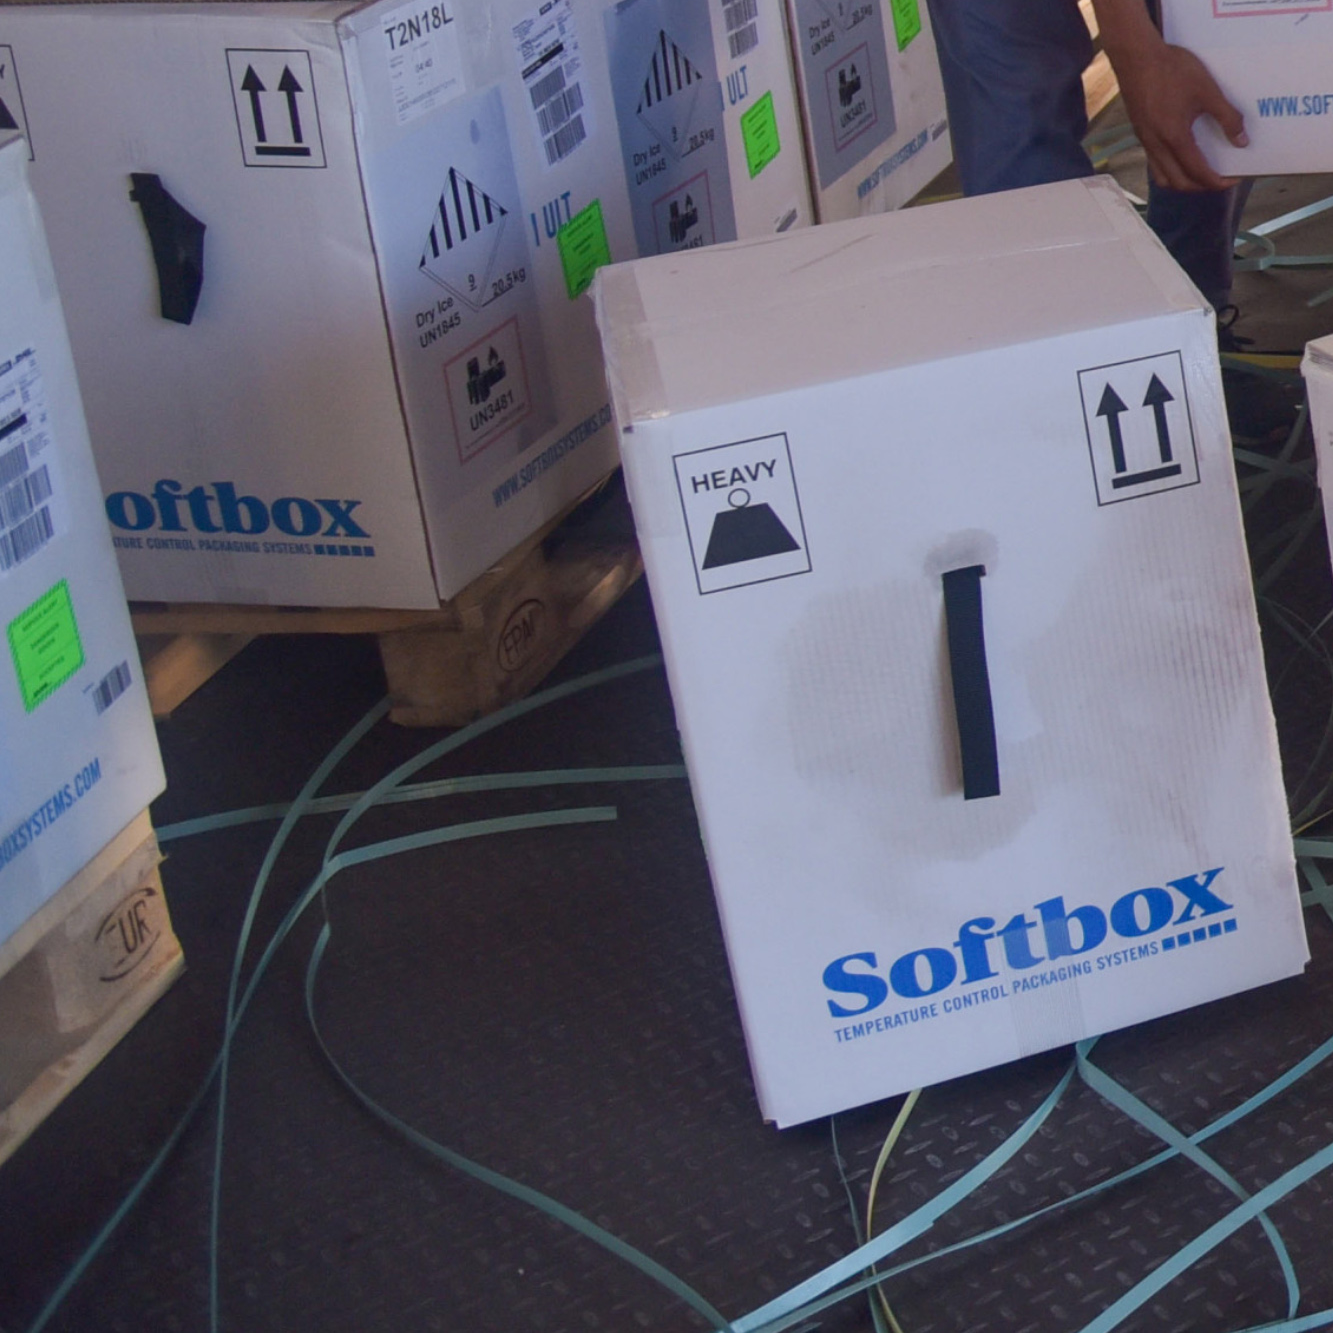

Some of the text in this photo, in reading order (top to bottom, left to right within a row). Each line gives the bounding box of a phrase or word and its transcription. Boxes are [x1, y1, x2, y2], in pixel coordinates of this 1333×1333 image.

[384, 3, 454, 51] T2N18L
[726, 66, 750, 106] ULT
[633, 144, 661, 167] Dry Ice
[636, 159, 667, 186] UN1845
[467, 273, 476, 287] 9
[415, 295, 454, 328] Dry Ice
[418, 314, 462, 349] UN1845
[469, 389, 515, 433] UN3481
[690, 458, 777, 494] HEAVY
[104, 478, 372, 539] oftbox
[146, 537, 195, 551] CONTROL
[199, 539, 260, 554] PACKAGING
[262, 542, 314, 556] SYSTEMS
[821, 866, 1235, 1019] Softbox
[834, 940, 1160, 1044] TEMPERATURE CONTROL PACKAGING SYSTEMS
